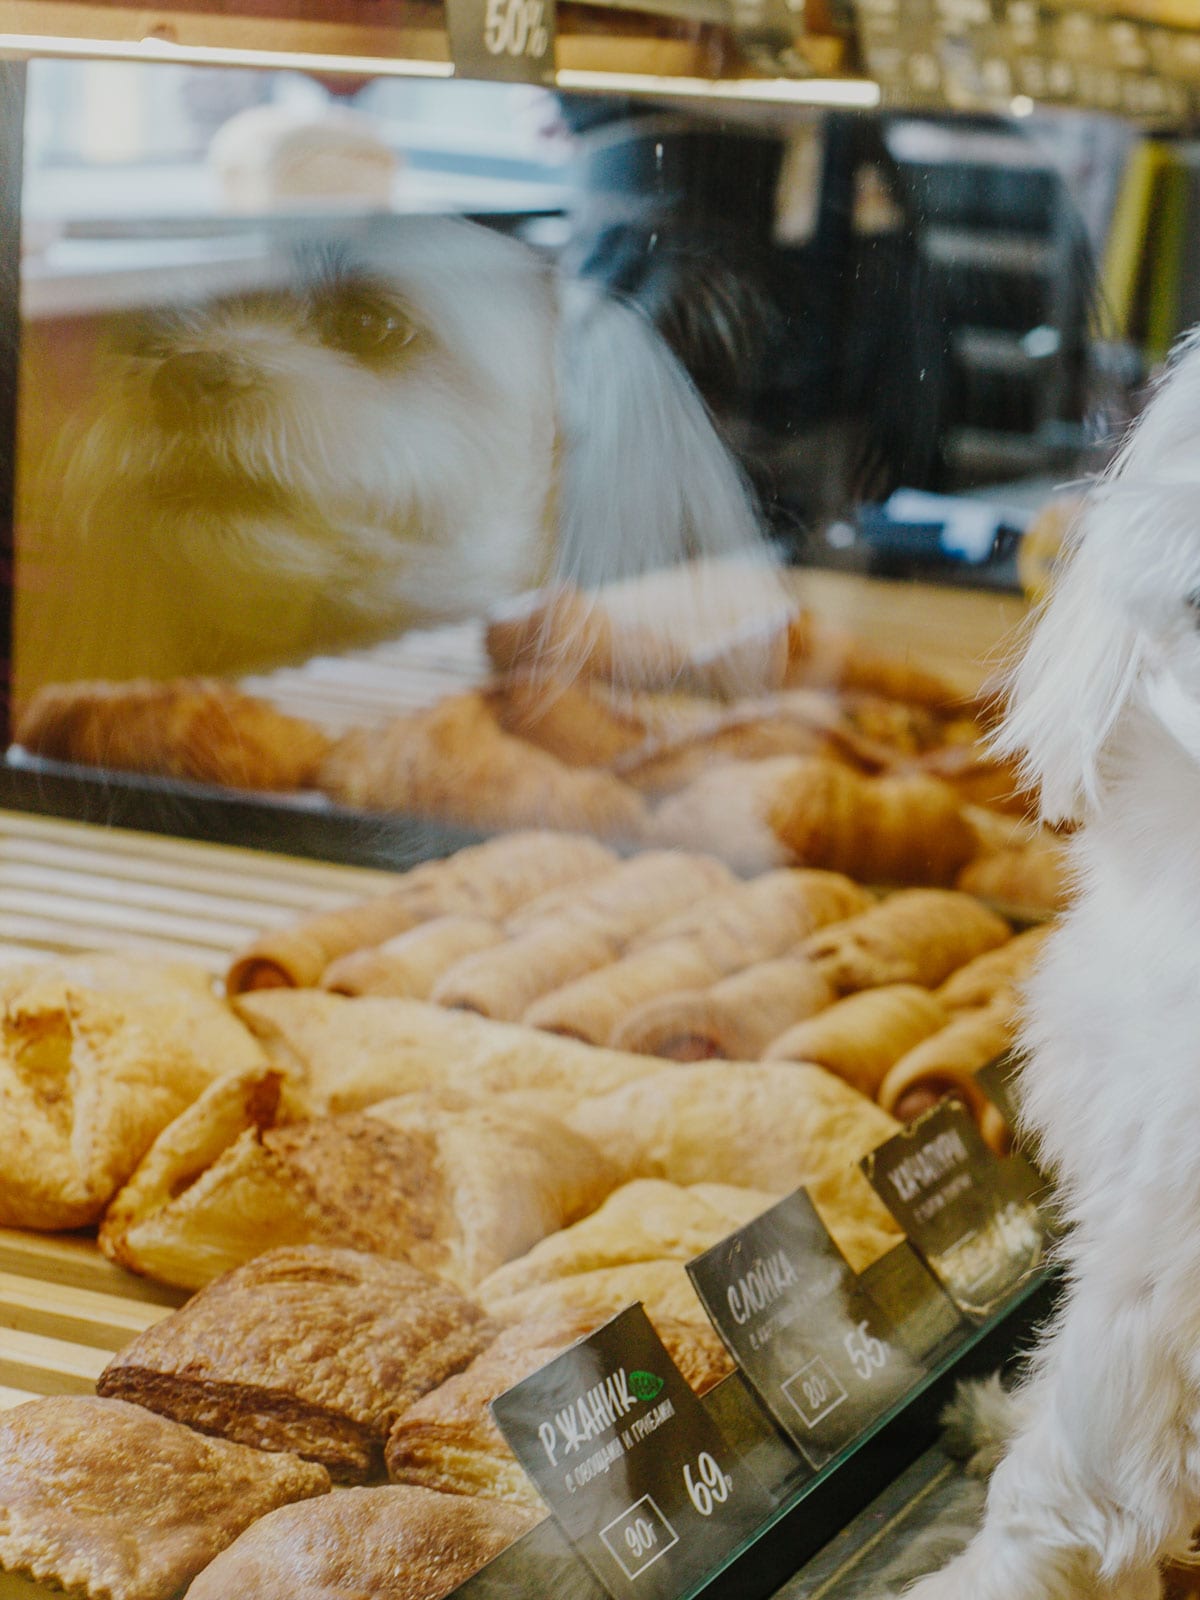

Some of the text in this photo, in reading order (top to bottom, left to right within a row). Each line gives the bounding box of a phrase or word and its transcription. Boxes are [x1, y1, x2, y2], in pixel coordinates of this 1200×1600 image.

[484, 0, 549, 57] 50%
[728, 1250, 799, 1325] СЛОЙКА
[538, 1367, 638, 1467] РЖАНИК
[574, 1437, 625, 1486] ОВОЩАМИ
[621, 1429, 634, 1450] И
[630, 1398, 676, 1442] ГРИБАМИ
